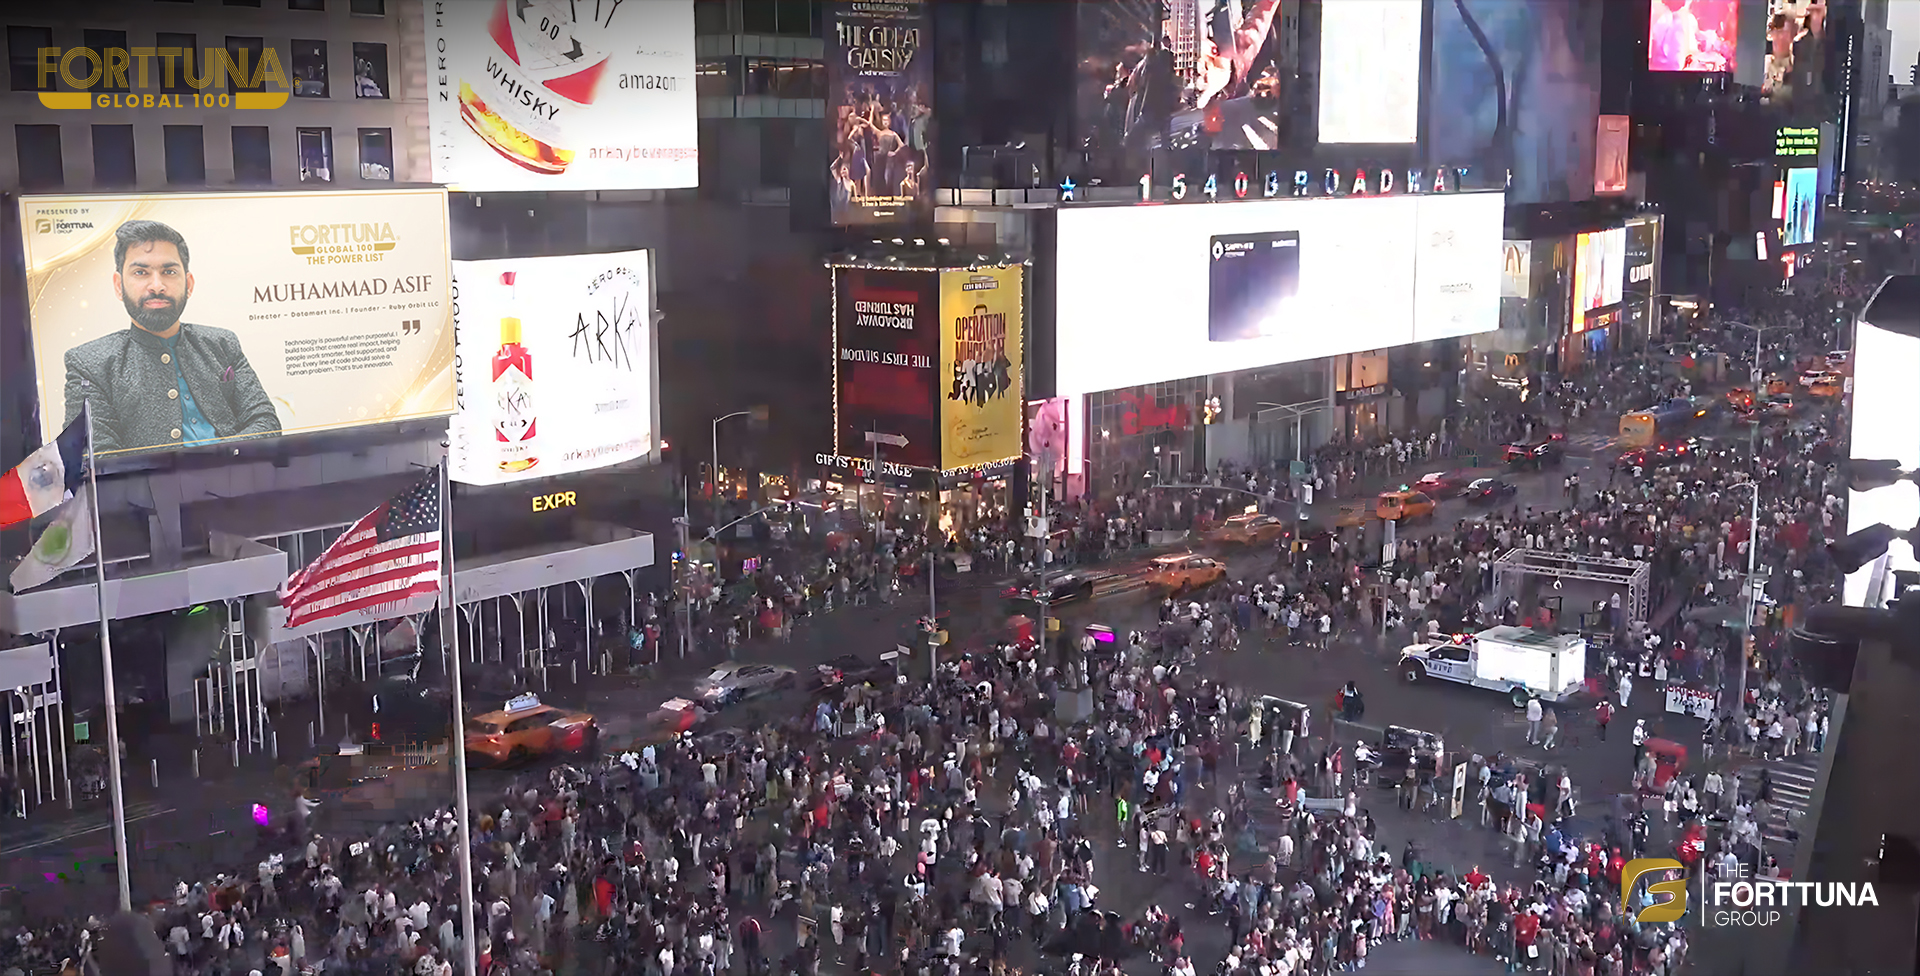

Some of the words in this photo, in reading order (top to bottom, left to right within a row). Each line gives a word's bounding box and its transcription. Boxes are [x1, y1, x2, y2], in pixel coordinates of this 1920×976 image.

[437, 37, 448, 102] ZERO
[487, 56, 559, 120] WHISKY
[619, 73, 677, 91] amazon
[1138, 171, 1249, 201] 1540
[56, 222, 94, 230] FORTTUNA
[290, 222, 396, 245] FORTTUNA
[316, 245, 354, 254] GLOBAL
[356, 243, 373, 252] 100
[306, 255, 325, 265] THE
[328, 254, 363, 264] POWER
[365, 253, 384, 262] LIST
[253, 278, 387, 304] MUHAMMAD
[392, 275, 432, 294] ASIF
[249, 313, 281, 321] Director
[855, 301, 892, 315] TURNED
[893, 304, 915, 317] HAS
[856, 312, 913, 330] BROADWAY
[285, 354, 305, 362] people
[881, 352, 909, 366] FIRST
[857, 460, 913, 478] LUGAGE
[532, 491, 577, 512] EXPR
